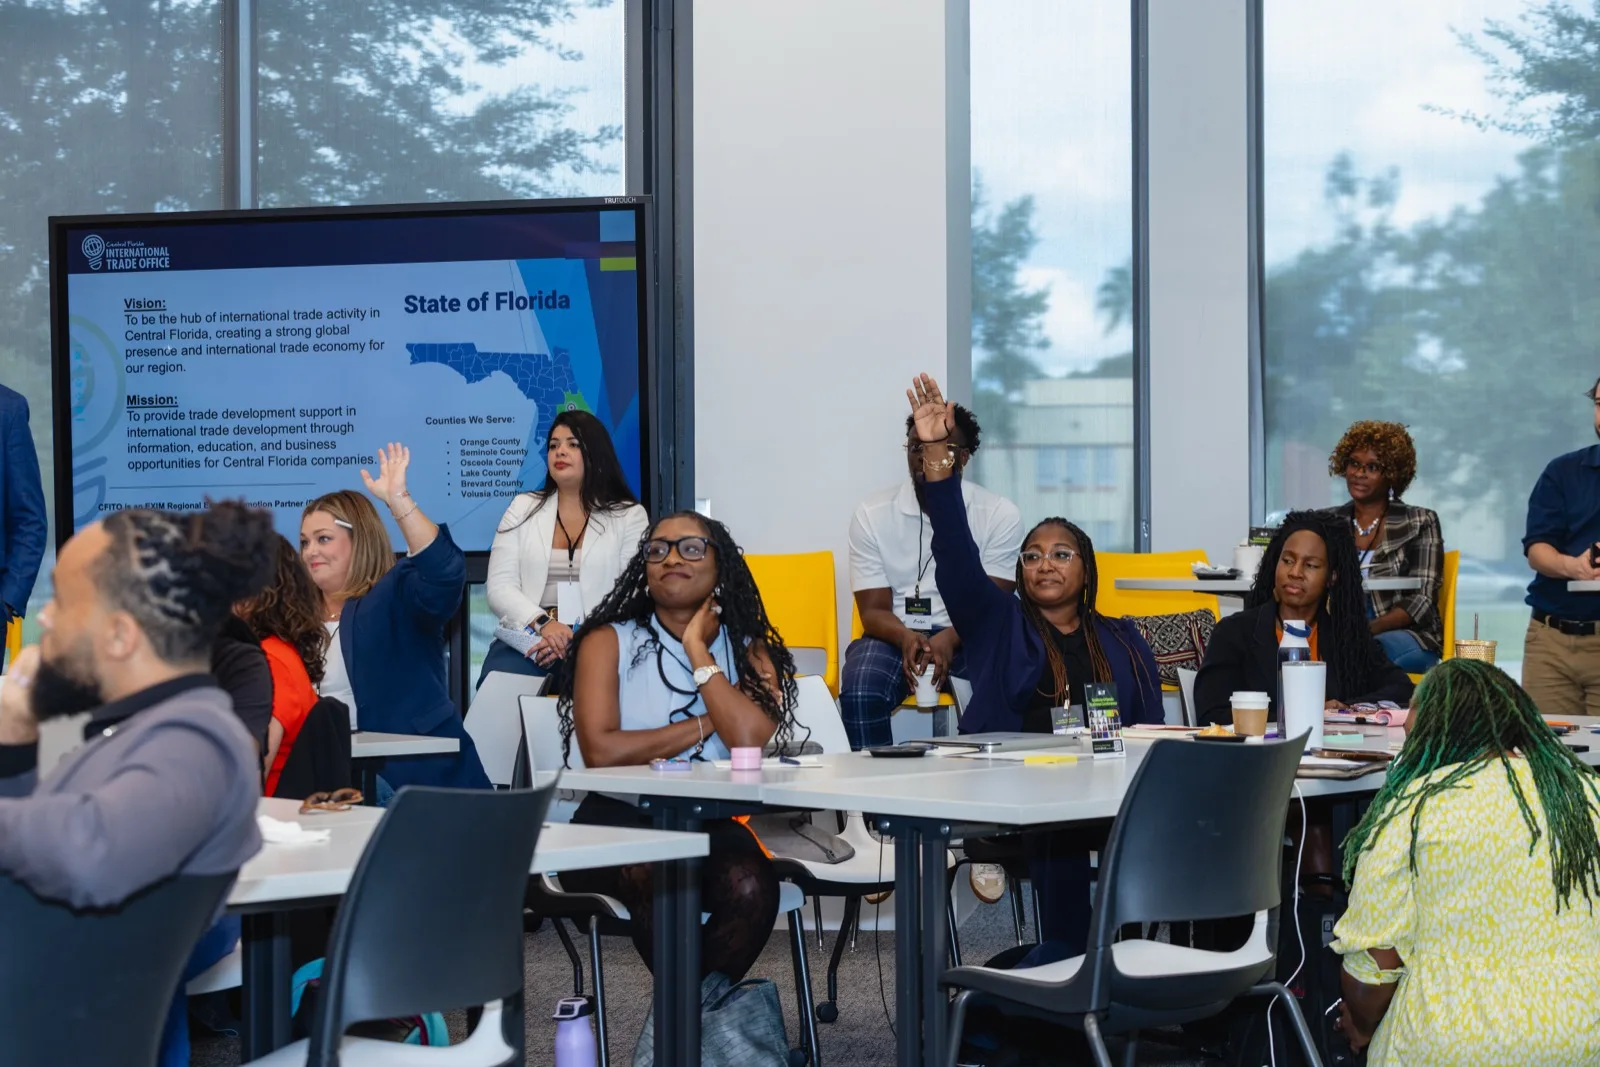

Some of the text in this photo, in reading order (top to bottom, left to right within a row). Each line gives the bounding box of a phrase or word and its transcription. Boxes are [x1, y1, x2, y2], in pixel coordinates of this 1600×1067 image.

[106, 247, 169, 257] INTERNATIONAL
[107, 257, 170, 270] TRADE OFFICE
[124, 297, 167, 312] Vision:
[404, 290, 570, 314] State of Florida
[125, 308, 380, 325] To be the hub of international trade activity in
[125, 325, 350, 342] Central Florida, creating a strong global
[125, 340, 385, 360] presence and international trade economy for
[125, 361, 186, 376] our region.
[126, 394, 178, 408] Mission:
[127, 405, 356, 424] To provide trade development support in
[426, 415, 515, 425] Counties We Serve:
[127, 421, 354, 439] international trade development through
[127, 439, 336, 456] information, education, and business
[460, 438, 520, 447] Orange County
[460, 448, 528, 457] Seminole County
[128, 454, 377, 472] opportunities for Central Florida companies.
[495, 459, 524, 467] County
[461, 469, 511, 478] Lake County
[495, 480, 524, 488] County
[461, 490, 491, 498] Volusia
[98, 503, 122, 511] CFITO
[168, 501, 201, 510] Regional
[275, 499, 303, 508] Partner
